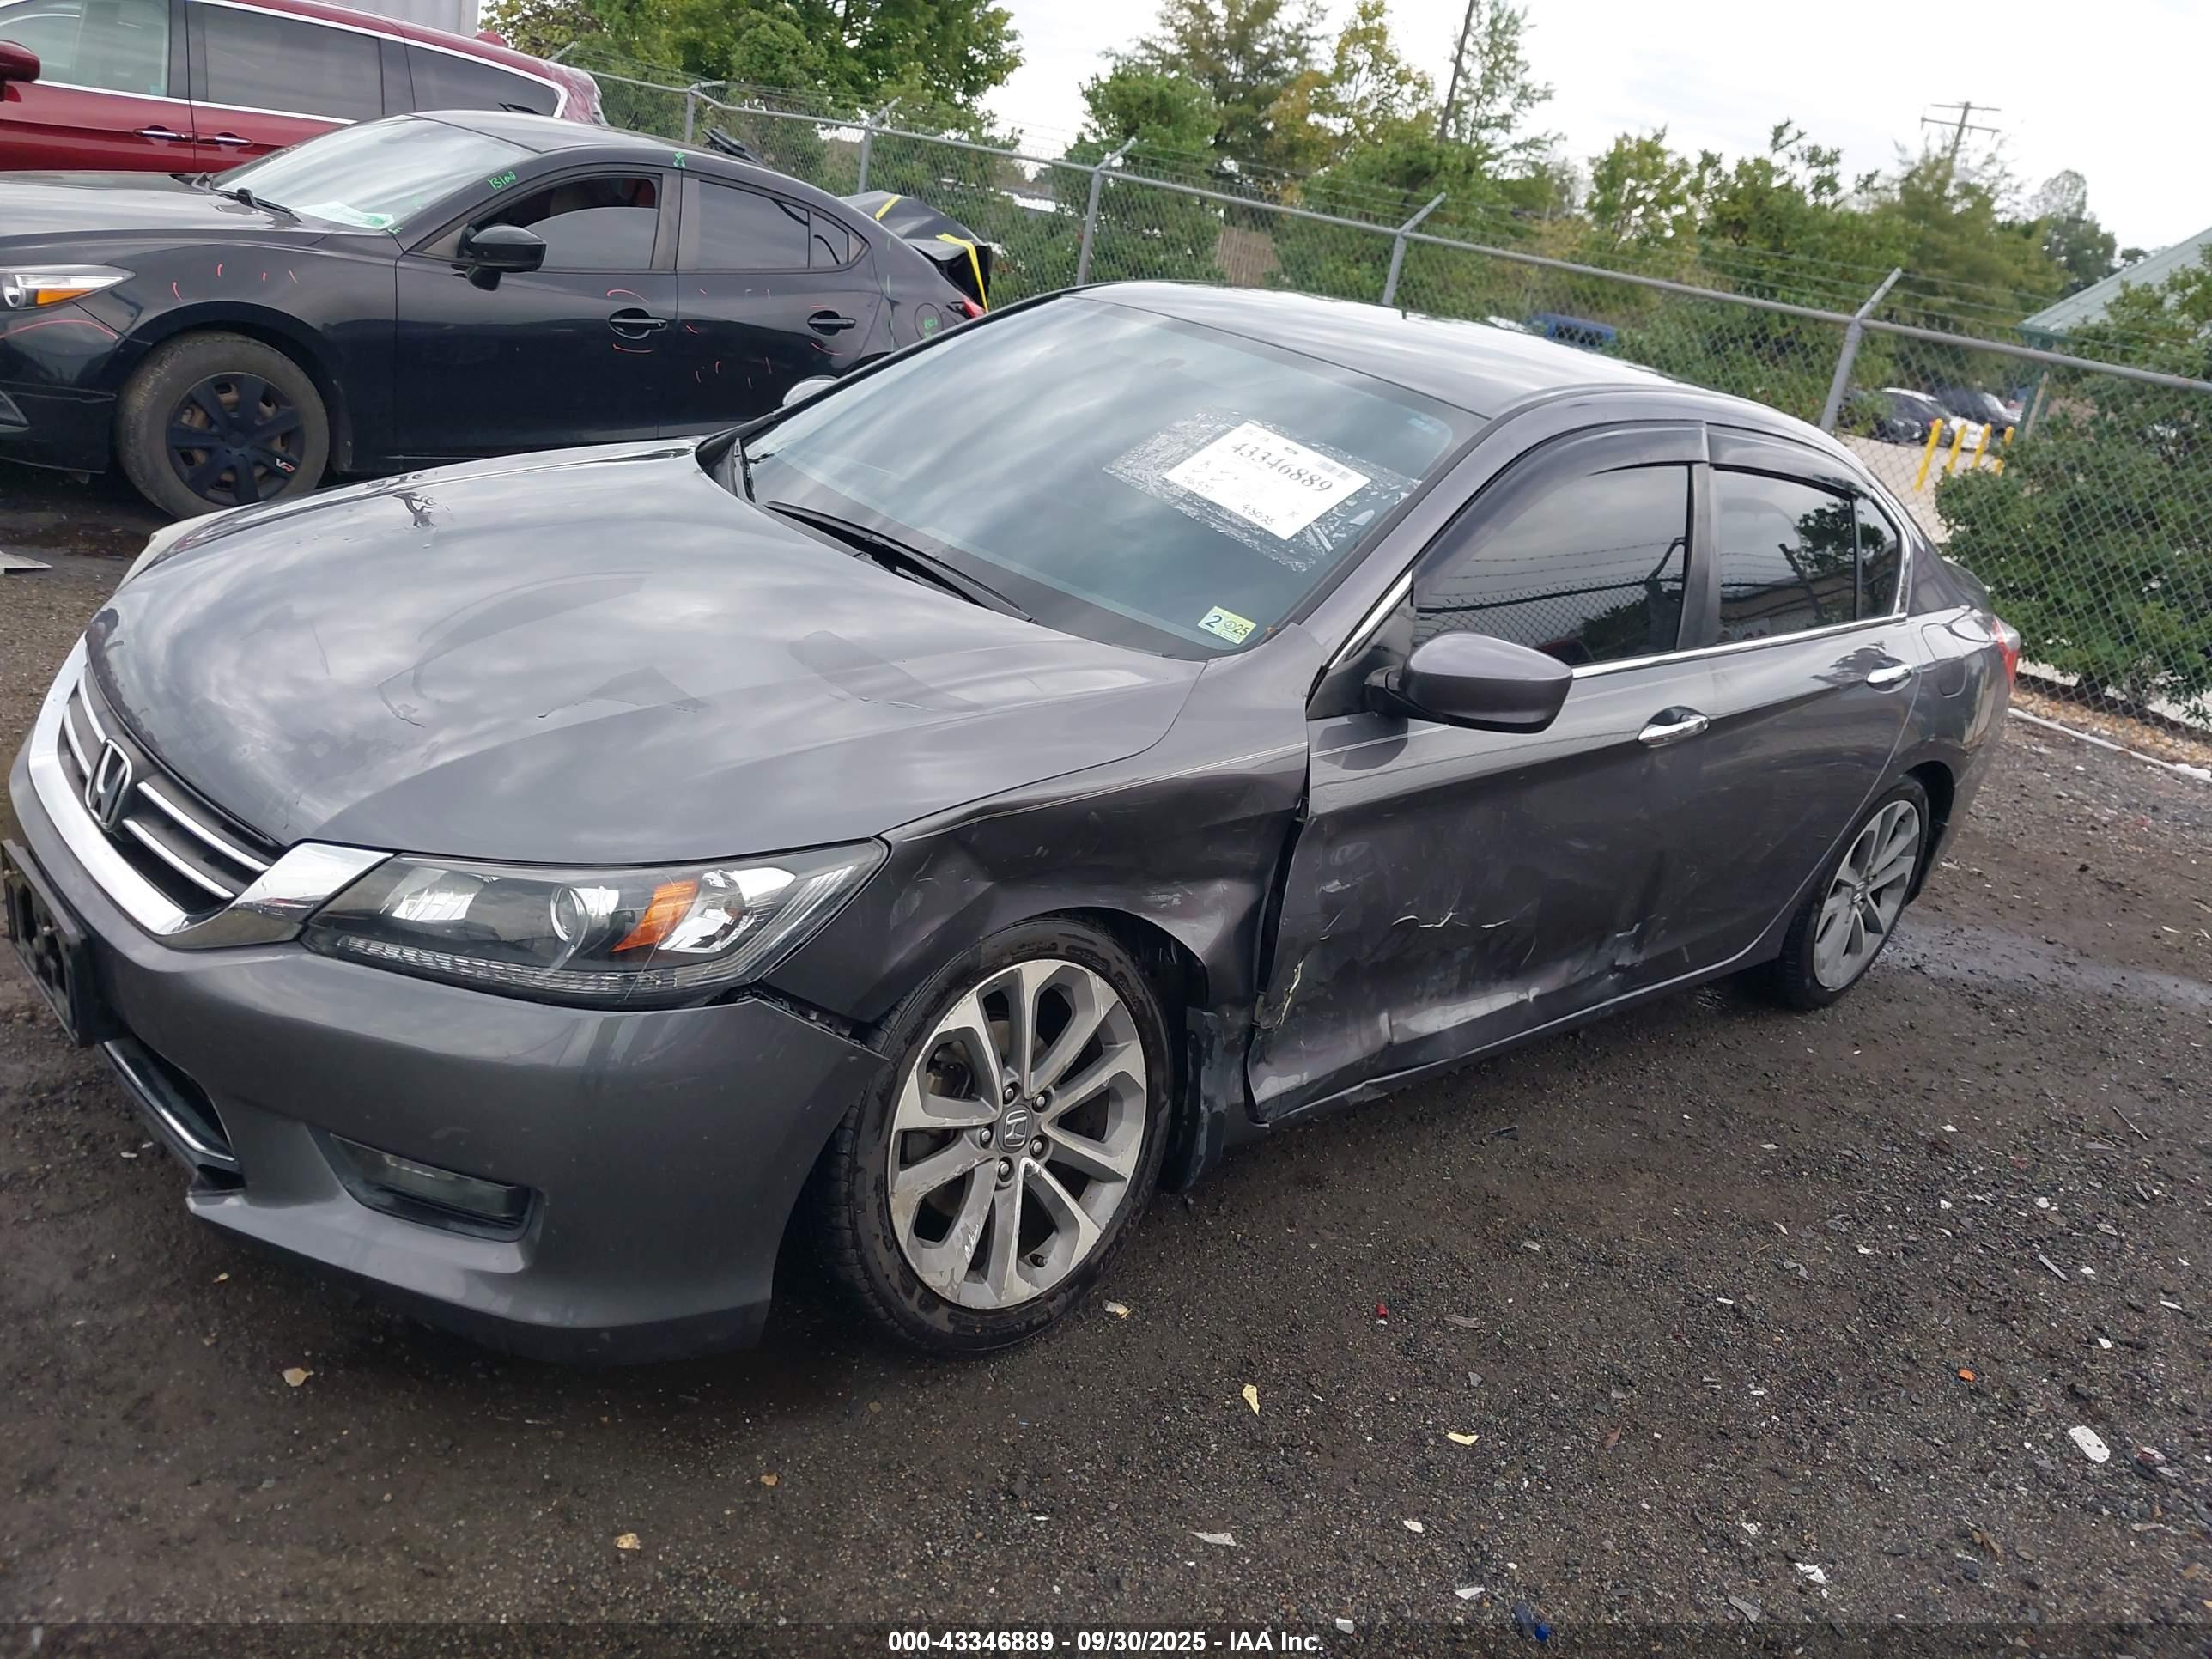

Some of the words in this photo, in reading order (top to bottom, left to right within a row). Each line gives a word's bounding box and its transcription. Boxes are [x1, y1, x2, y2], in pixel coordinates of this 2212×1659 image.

[1231, 443, 1333, 492] 43346889
[1205, 615, 1223, 629] 2
[1232, 623, 1251, 636] 25
